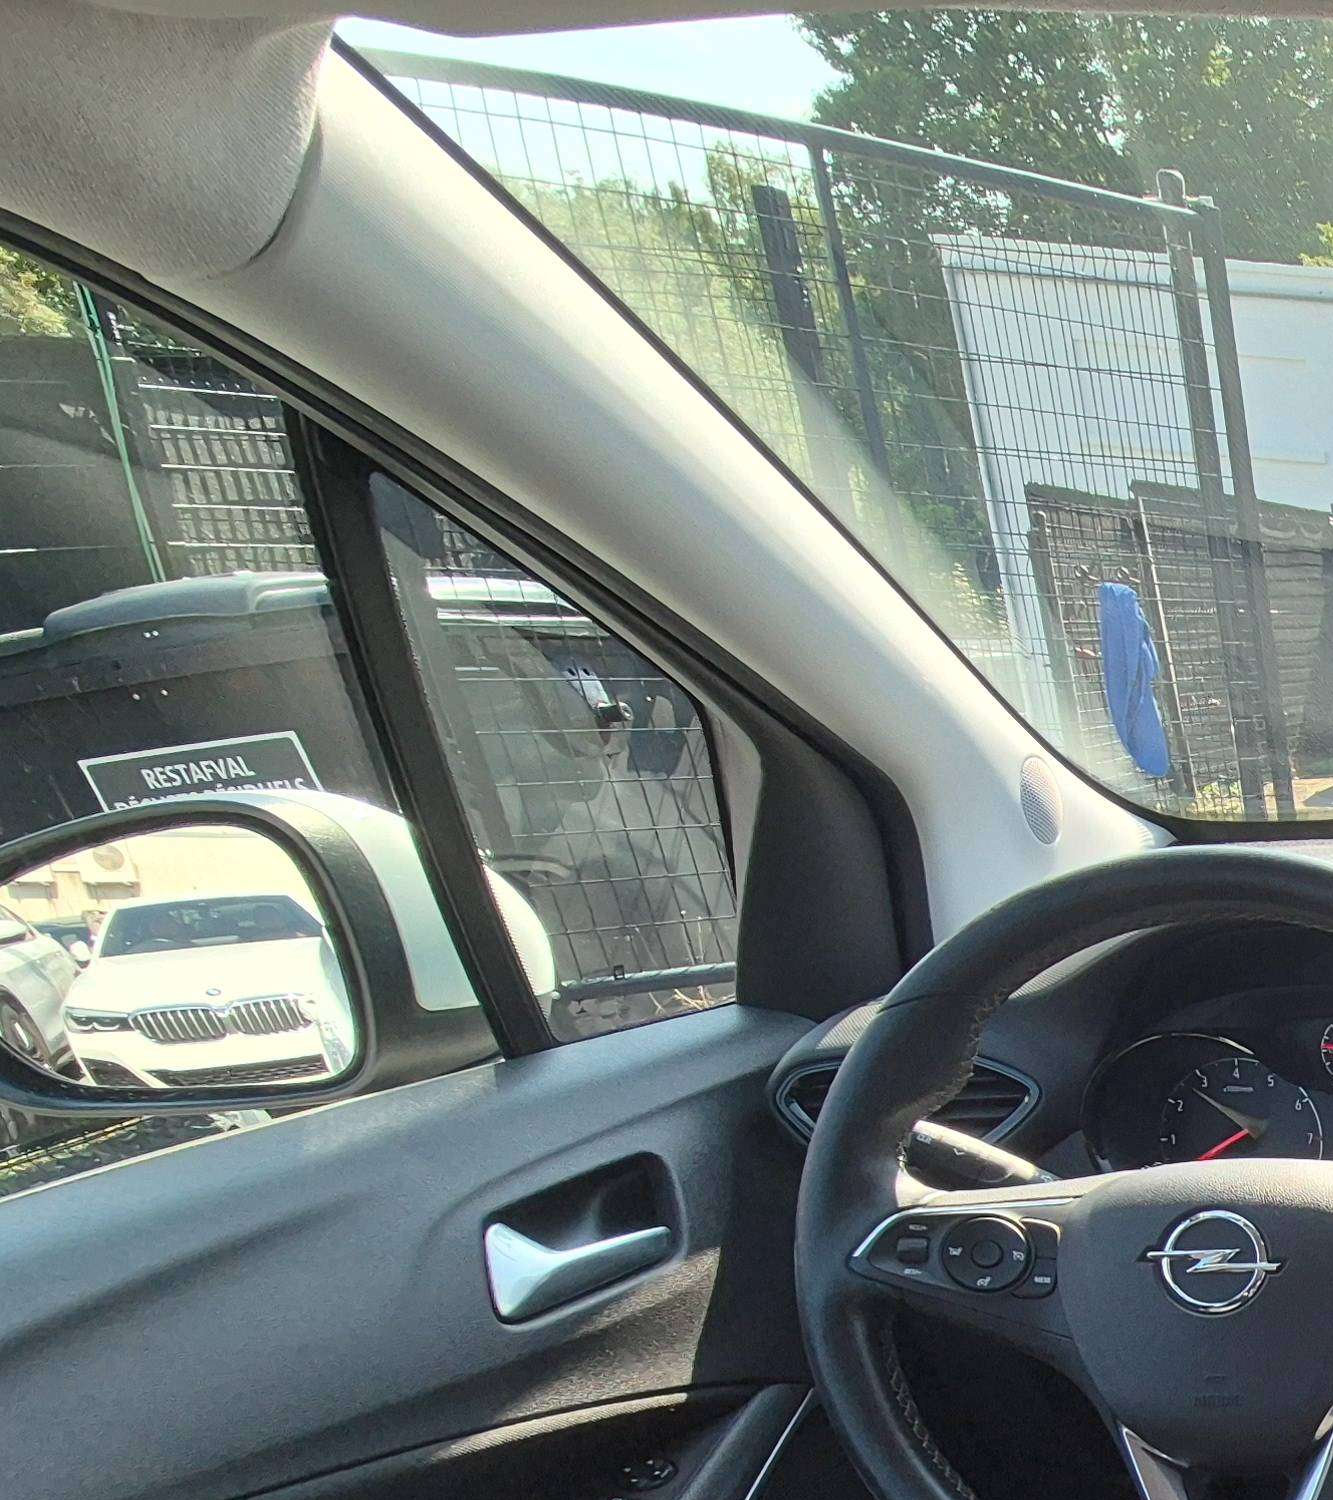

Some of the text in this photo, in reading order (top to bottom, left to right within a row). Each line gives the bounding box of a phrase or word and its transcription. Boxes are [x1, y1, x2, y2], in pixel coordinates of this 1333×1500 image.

[141, 756, 255, 789] RESTAFVAL
[1232, 1067, 1240, 1079] 4
[1201, 1075, 1208, 1088] 3
[1268, 1075, 1275, 1087] 5
[1177, 1099, 1184, 1112] 2
[1295, 1098, 1302, 1111] 6
[1307, 1132, 1314, 1145] 7
